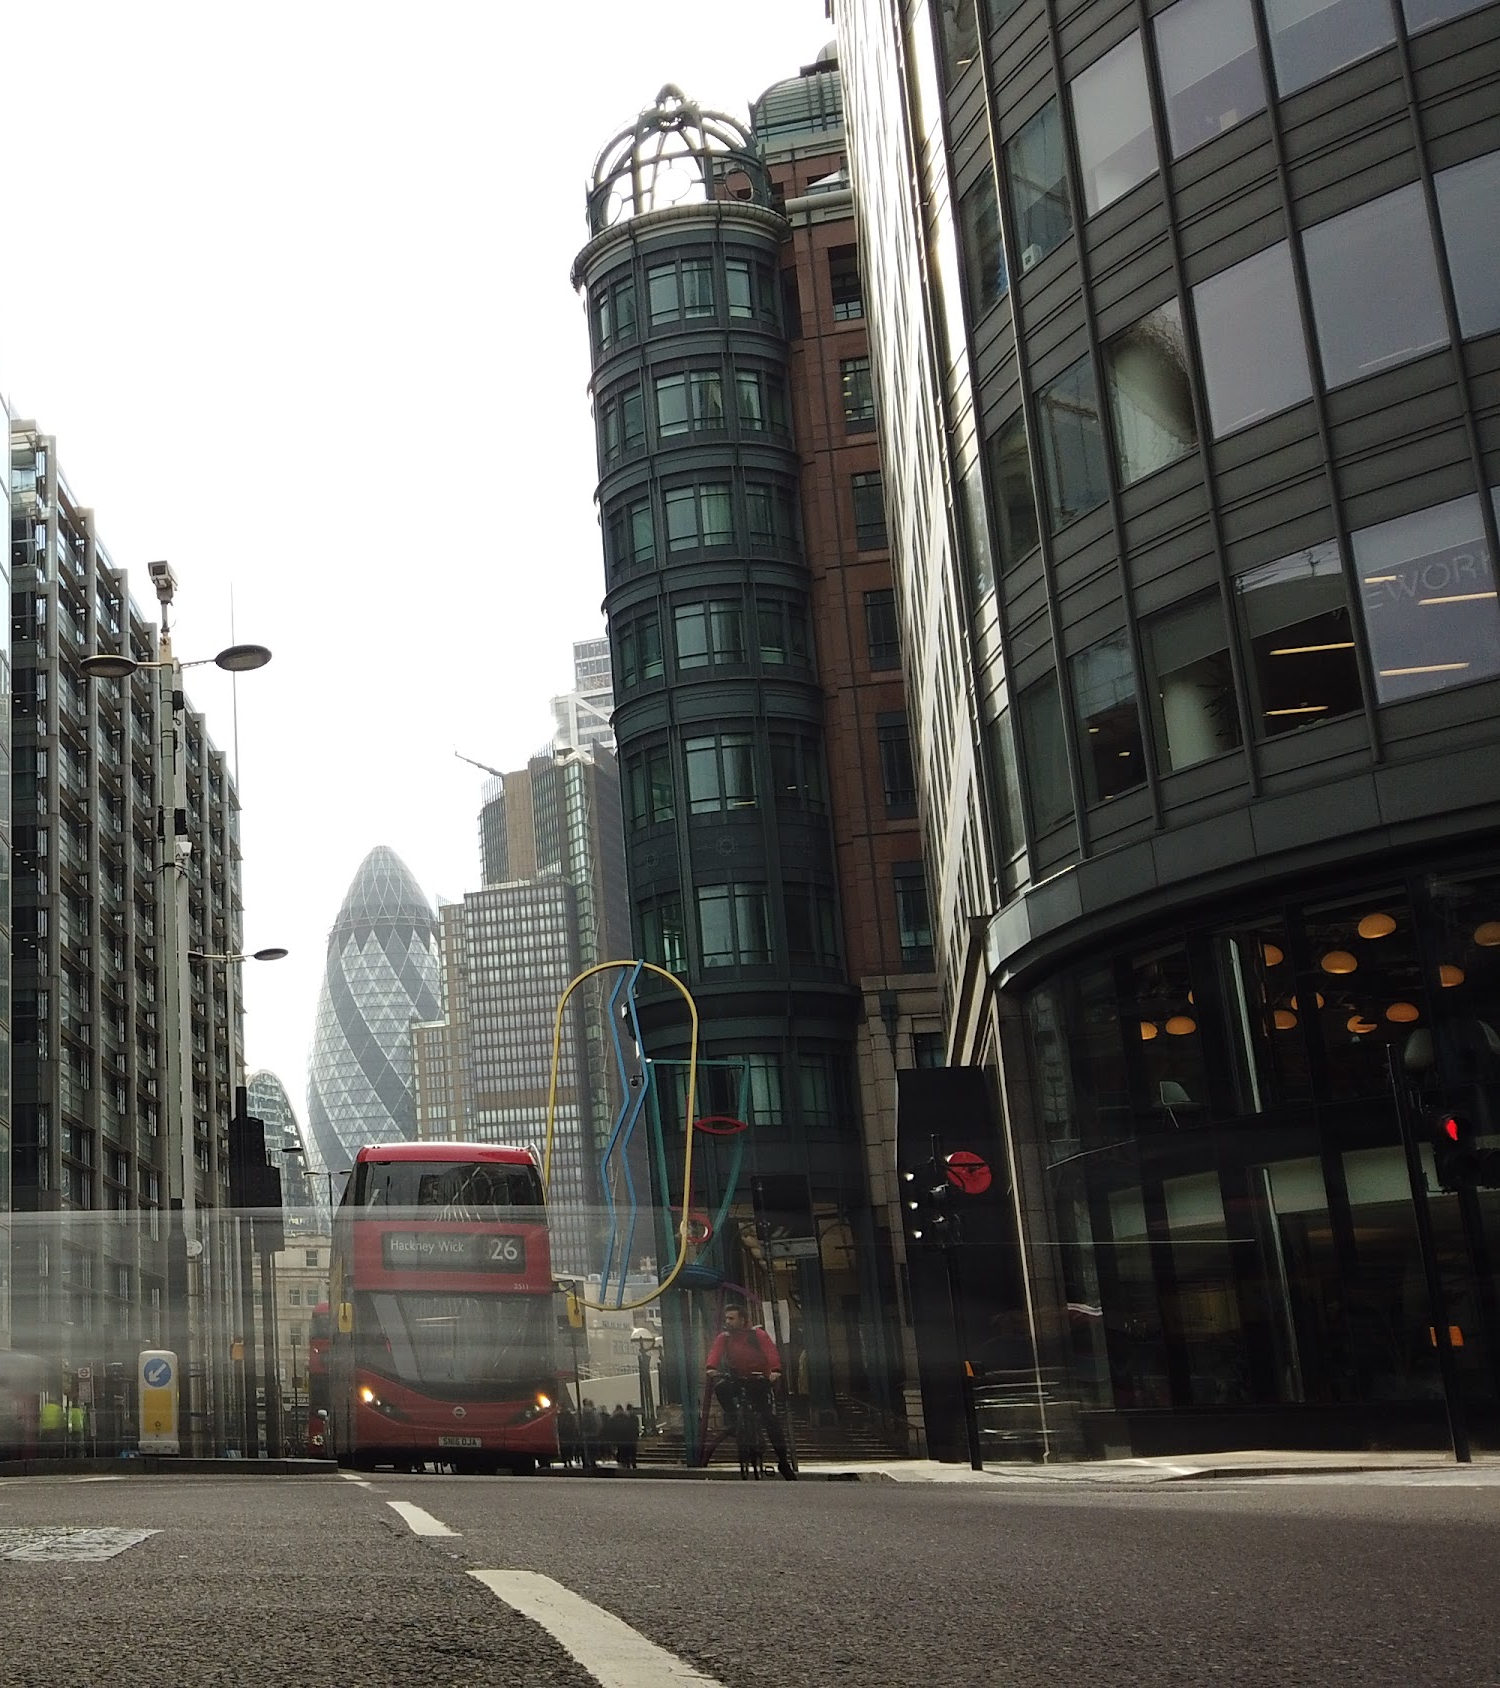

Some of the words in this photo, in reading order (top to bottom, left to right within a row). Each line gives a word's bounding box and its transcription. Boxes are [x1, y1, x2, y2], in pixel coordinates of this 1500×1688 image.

[390, 1239, 435, 1255] Hackney
[438, 1240, 465, 1253] Wick
[490, 1238, 518, 1261] 26
